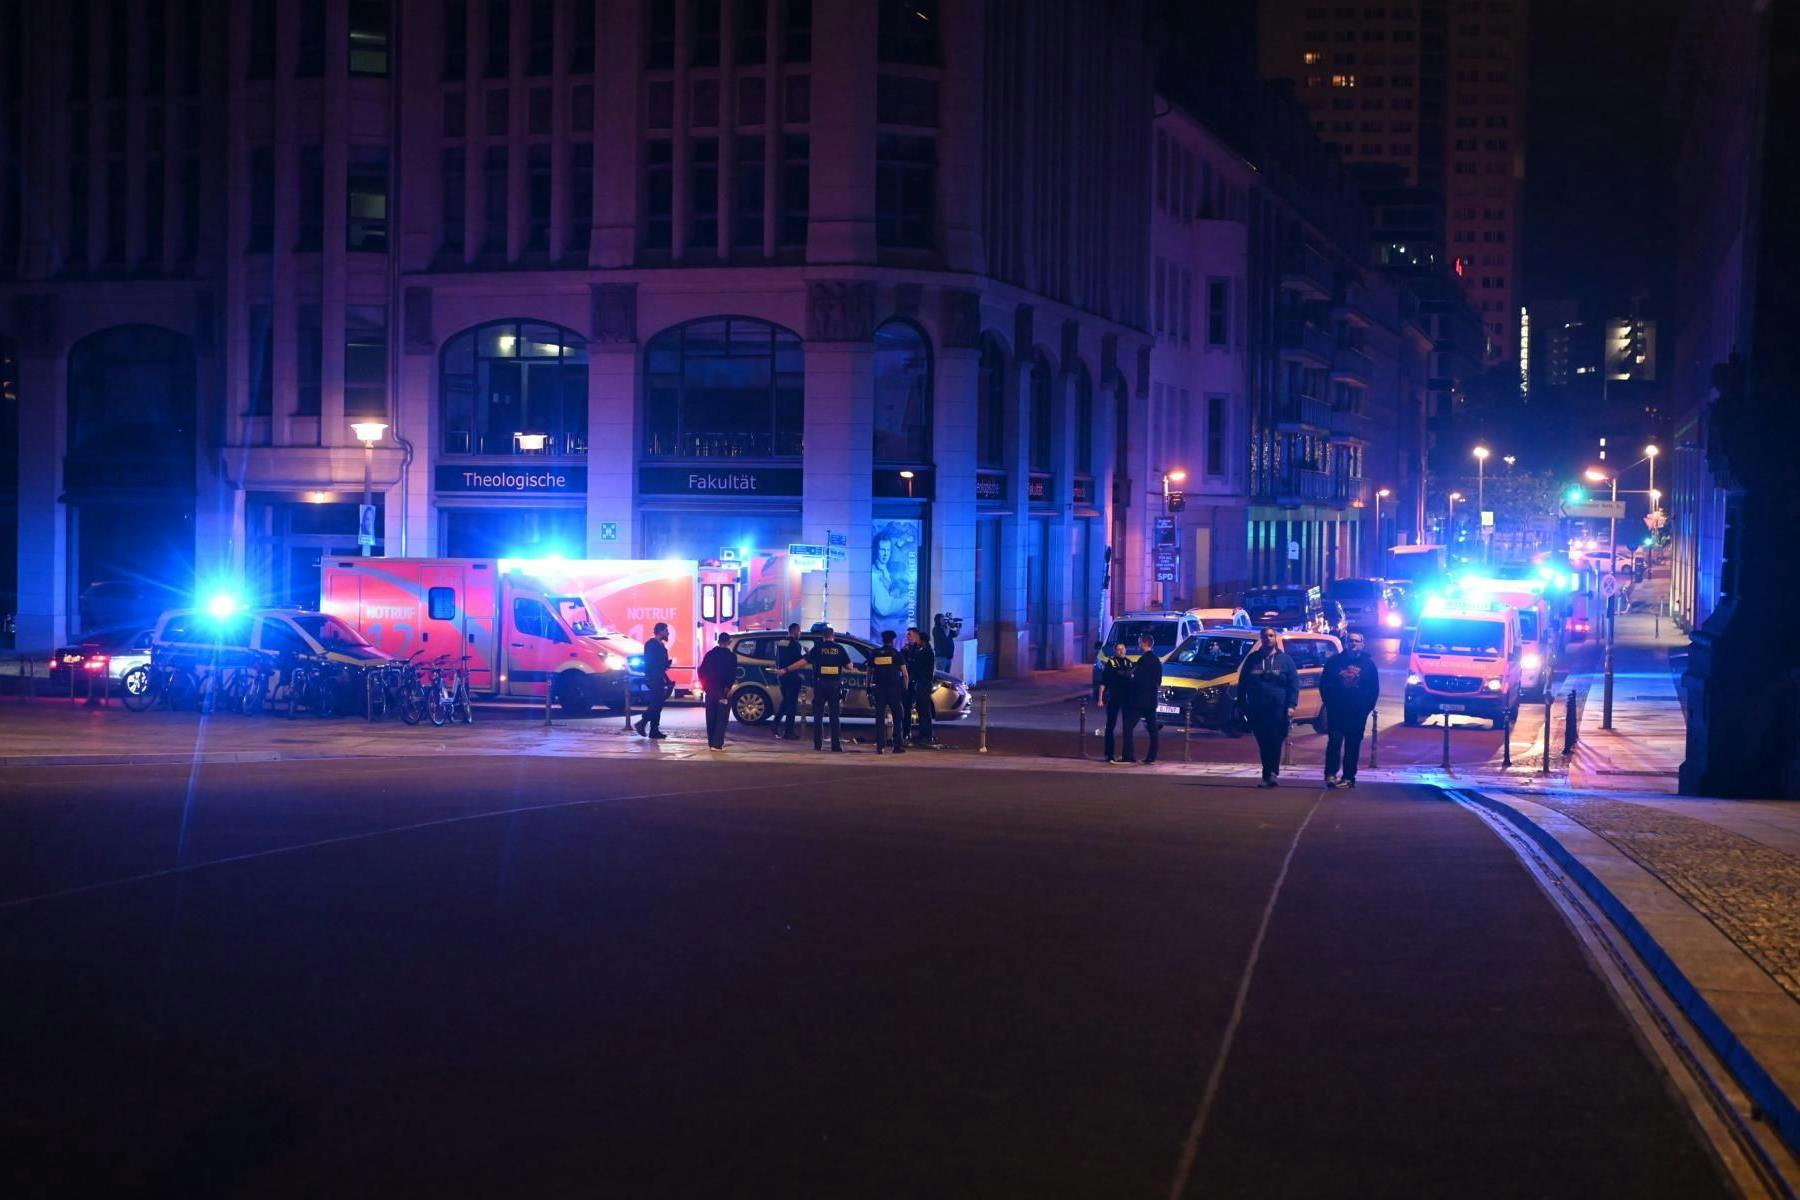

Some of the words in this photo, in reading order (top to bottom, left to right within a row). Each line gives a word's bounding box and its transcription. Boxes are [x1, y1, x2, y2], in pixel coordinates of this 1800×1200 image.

[463, 472, 566, 490] Theologische
[689, 474, 757, 490] Fakultät
[1157, 572, 1174, 581] SPD
[367, 606, 416, 619] NOTRUF
[627, 607, 678, 620] NOTRUF
